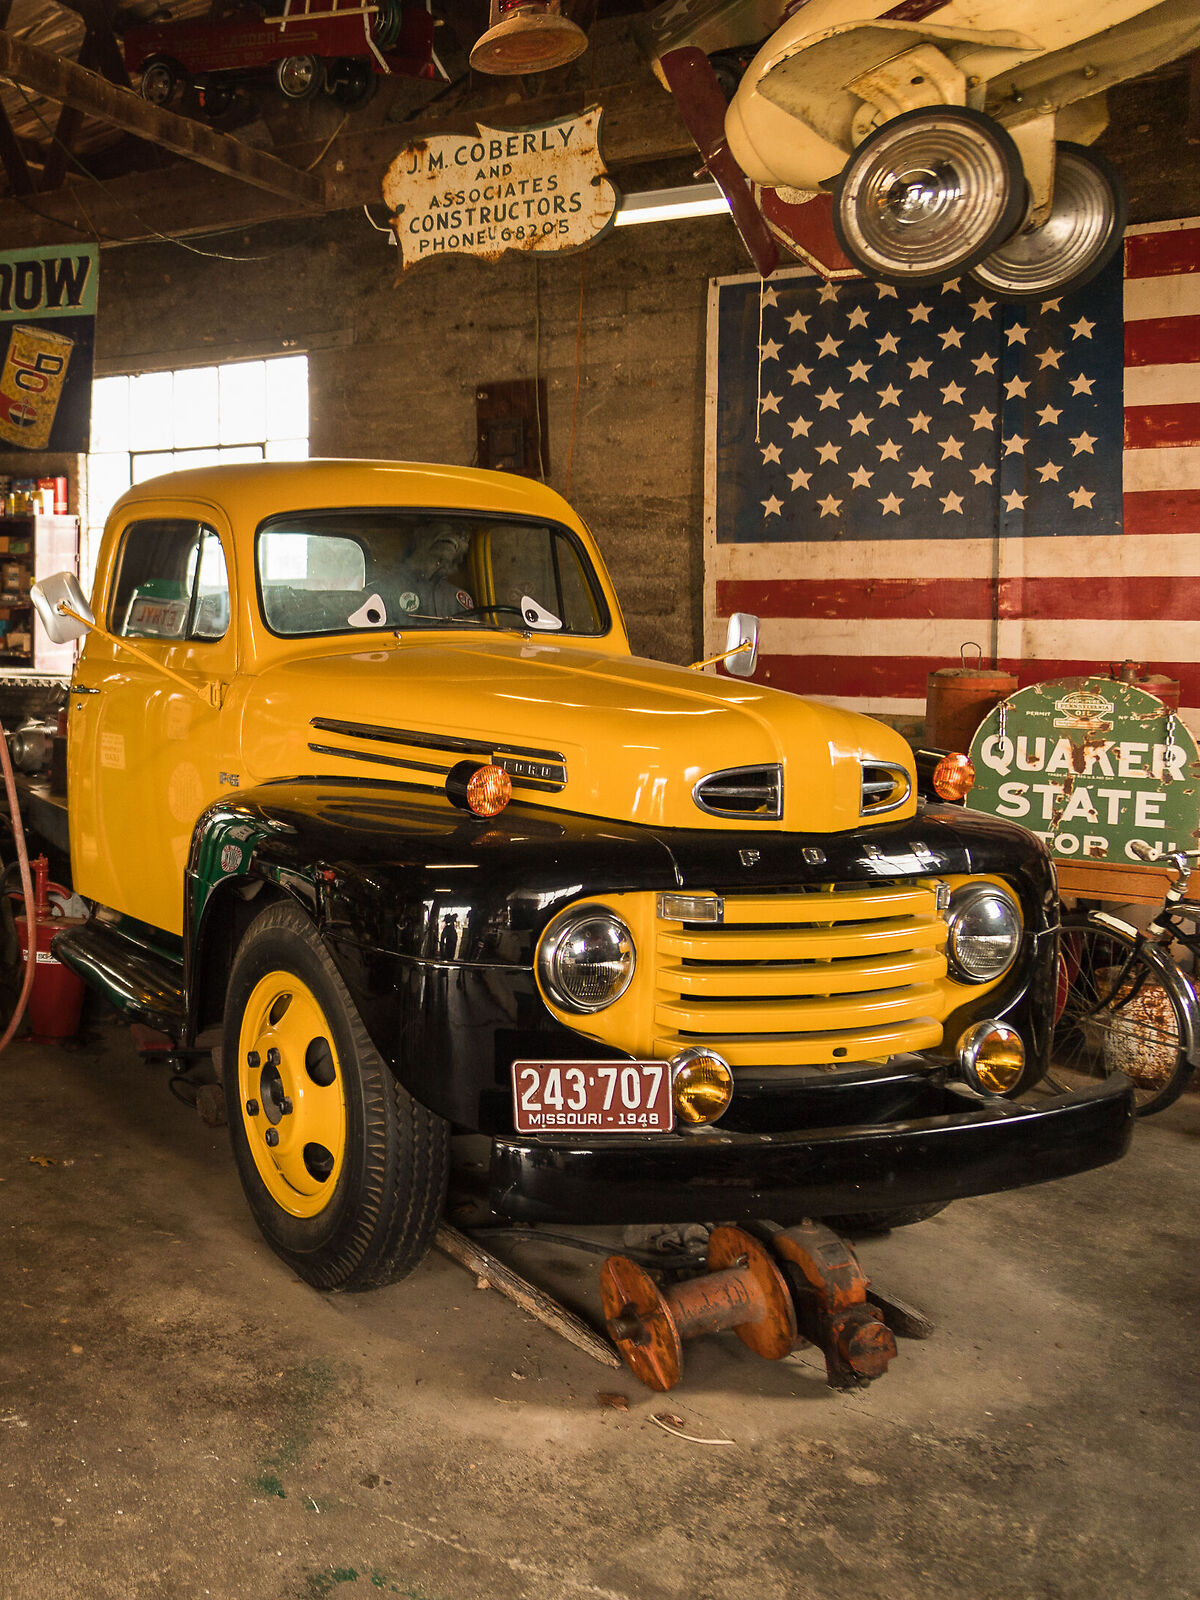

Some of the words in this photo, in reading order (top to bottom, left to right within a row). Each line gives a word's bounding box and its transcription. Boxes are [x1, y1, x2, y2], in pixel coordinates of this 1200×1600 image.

[455, 126, 575, 166] COBERLY
[475, 163, 512, 180] AND
[429, 175, 558, 210] ASSOCIATES
[409, 192, 582, 234] CONSTRUCTORS
[420, 230, 486, 253] PHONE
[504, 760, 551, 777] FORD
[981, 734, 1187, 781] QUAKER
[996, 782, 1167, 829] STATE
[1034, 831, 1109, 857] TOR
[528, 1113, 602, 1126] MISSOURI
[618, 1113, 659, 1126] 1948
